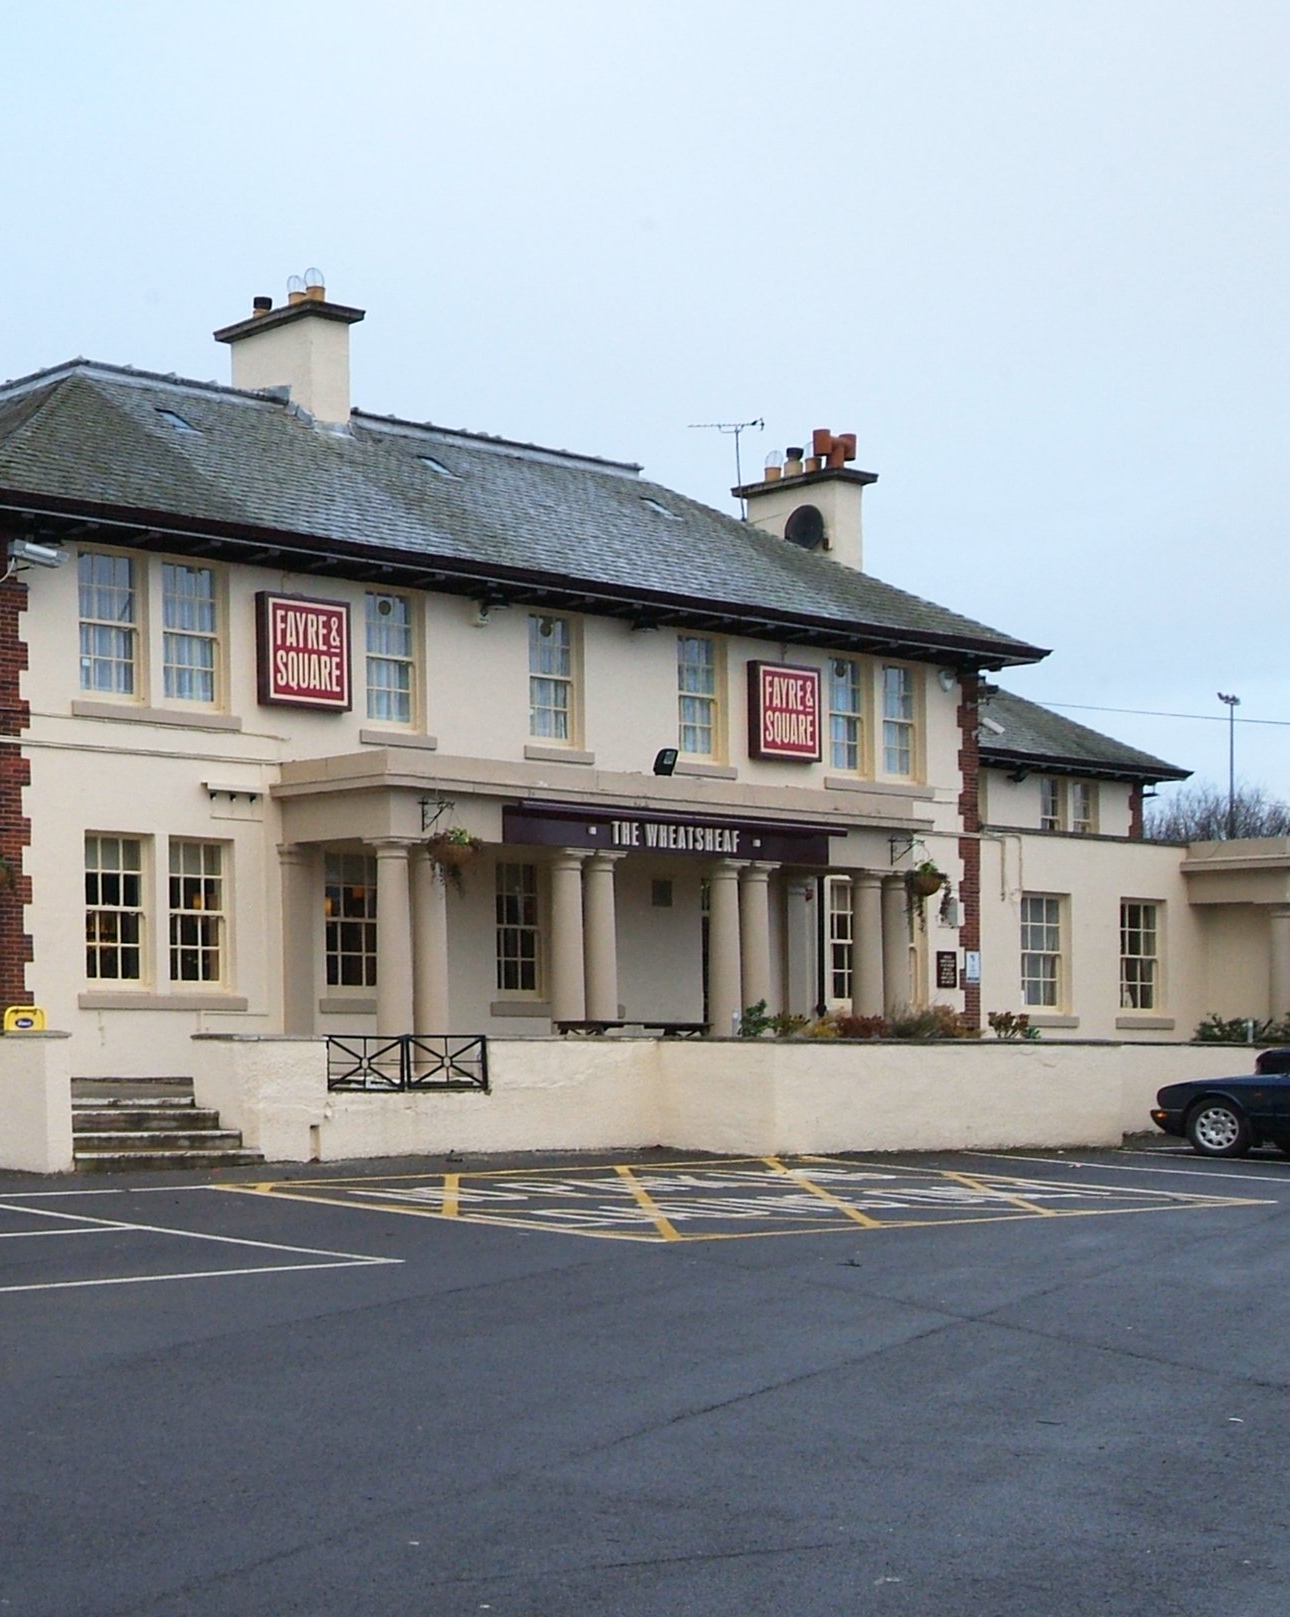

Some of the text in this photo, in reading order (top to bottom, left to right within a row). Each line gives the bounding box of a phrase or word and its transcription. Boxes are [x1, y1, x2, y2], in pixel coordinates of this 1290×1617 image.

[276, 609, 341, 653] FAYRE &
[276, 649, 341, 692] SQUARE
[765, 675, 814, 712] FAYRE &
[765, 710, 814, 746] SQUARE
[611, 820, 741, 853] THE WHEATSHEAF
[347, 1168, 897, 1204] NO PARKING
[462, 1193, 909, 1229] LOADING
